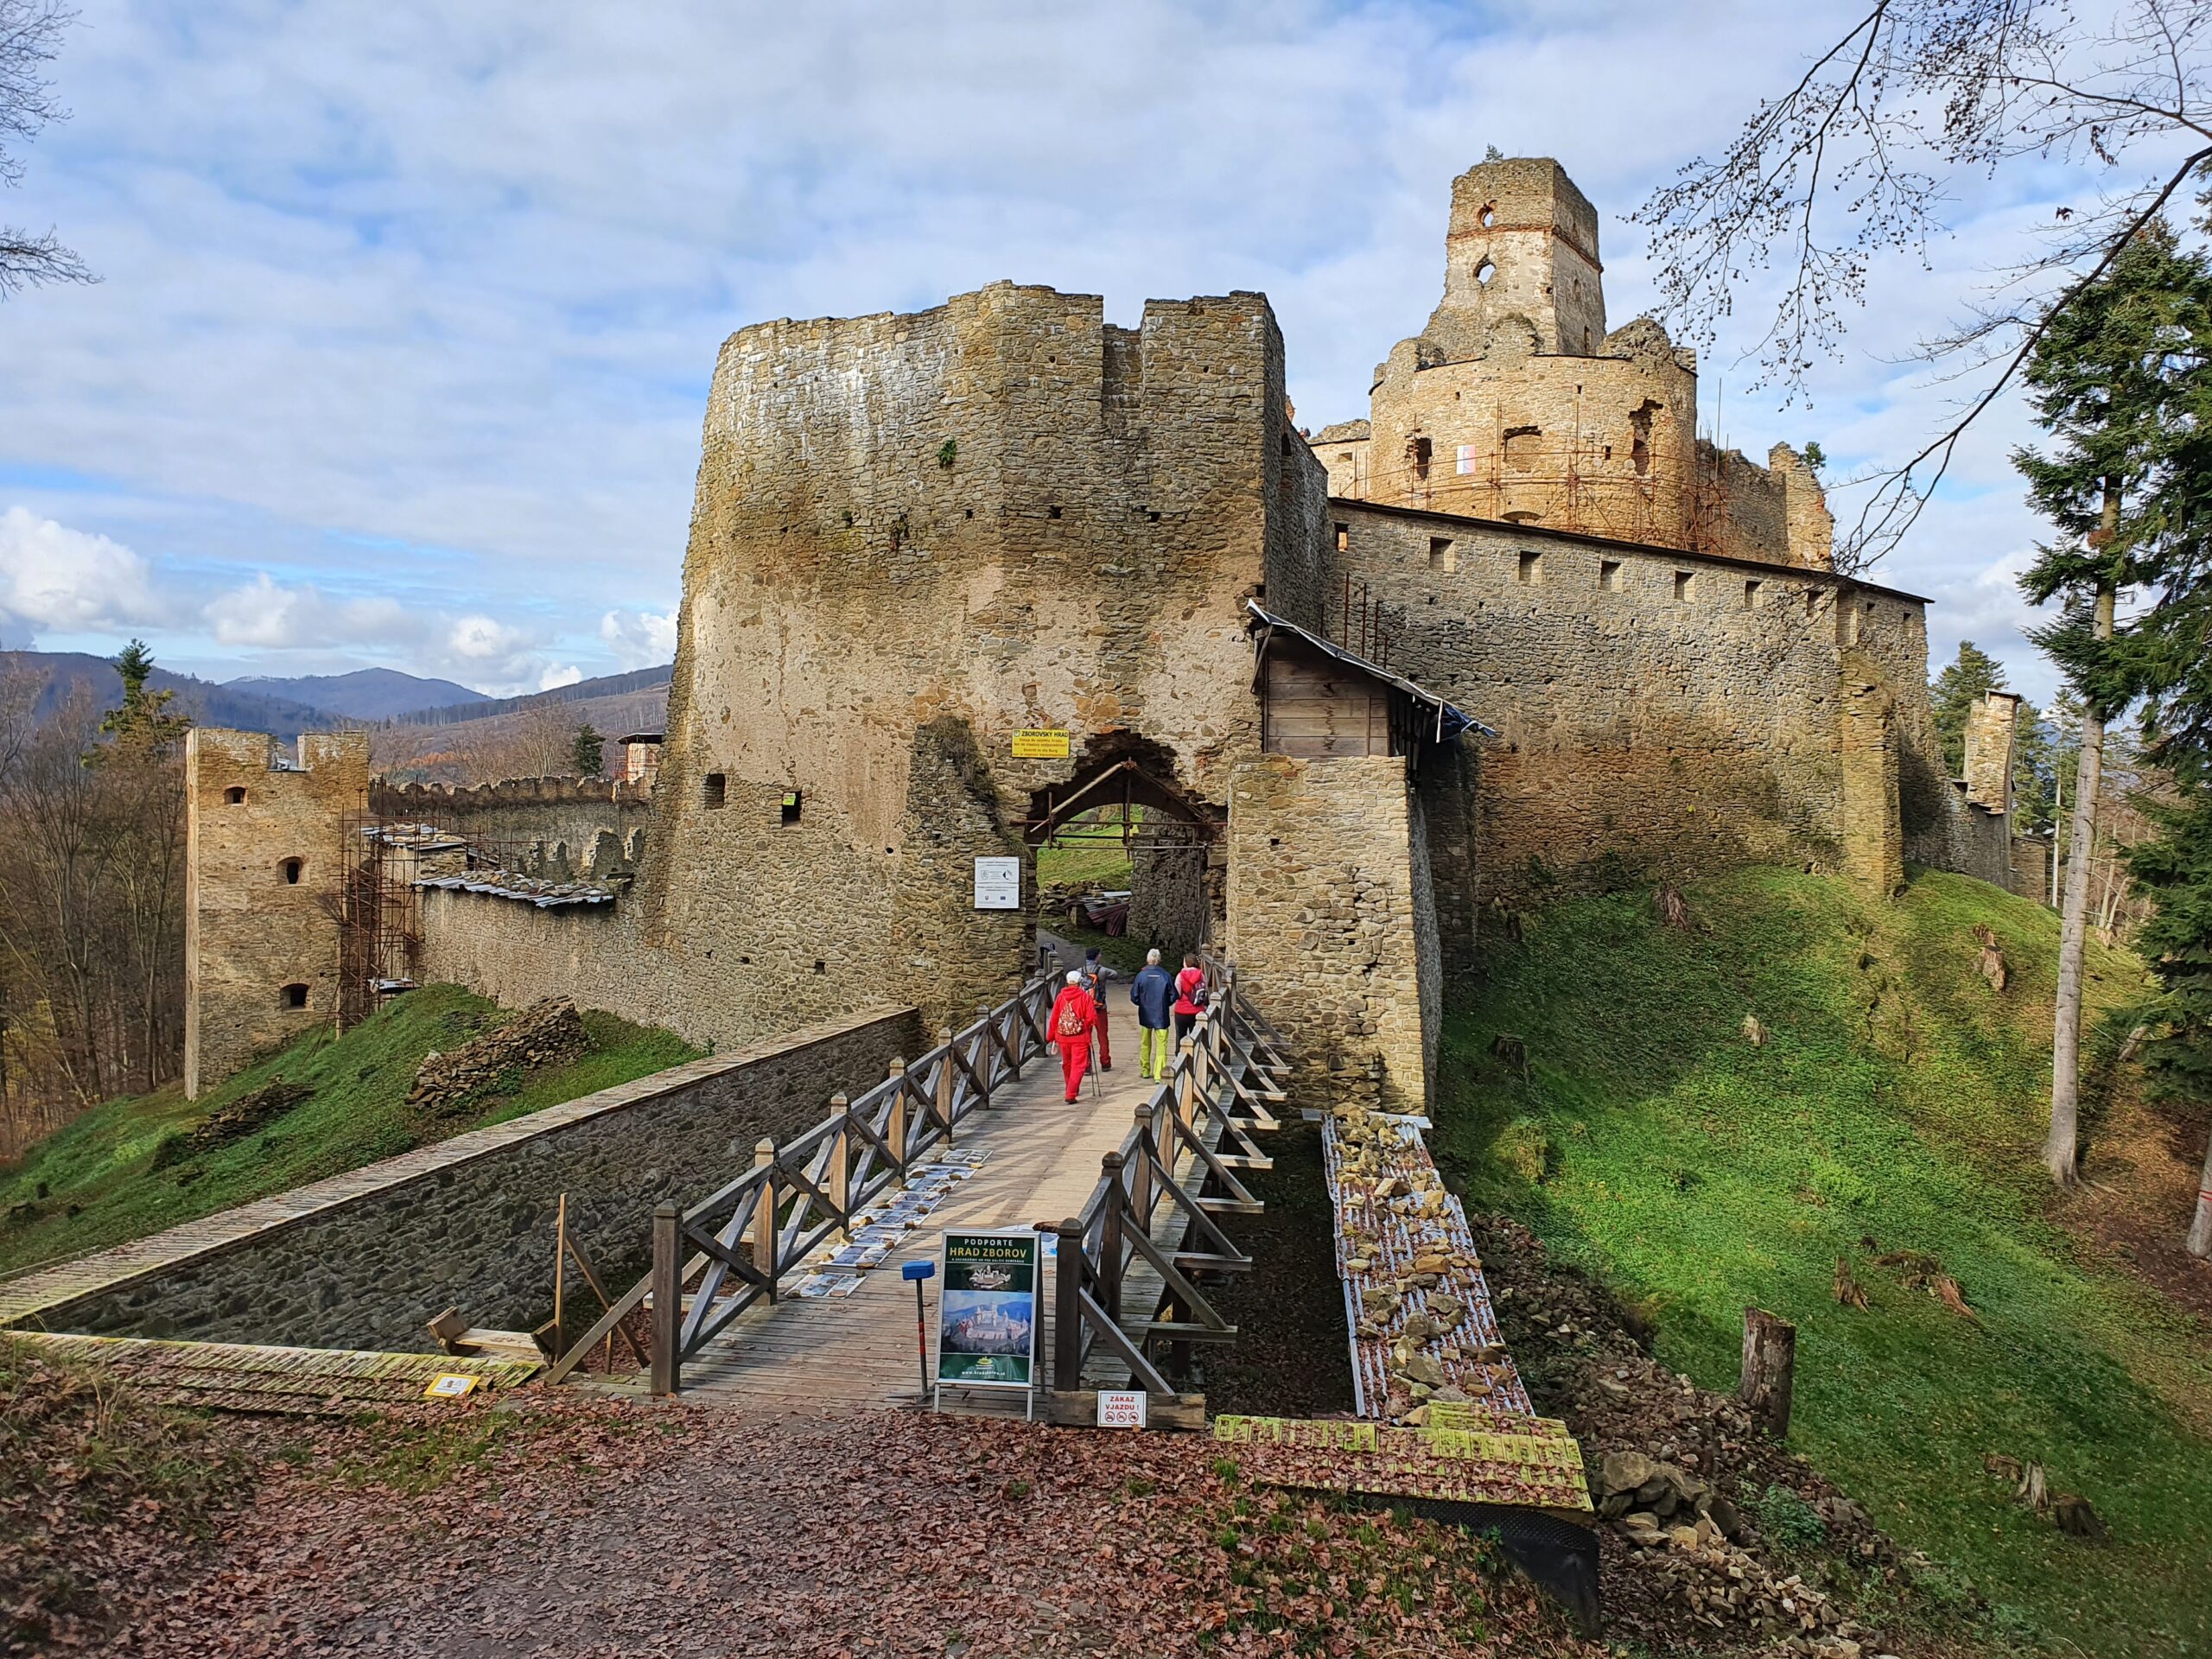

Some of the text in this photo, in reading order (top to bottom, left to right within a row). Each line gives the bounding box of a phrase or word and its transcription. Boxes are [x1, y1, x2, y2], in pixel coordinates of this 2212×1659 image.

[963, 1238, 1014, 1247] PODPORTE
[949, 1247, 1027, 1258] HRAD ZBOROV
